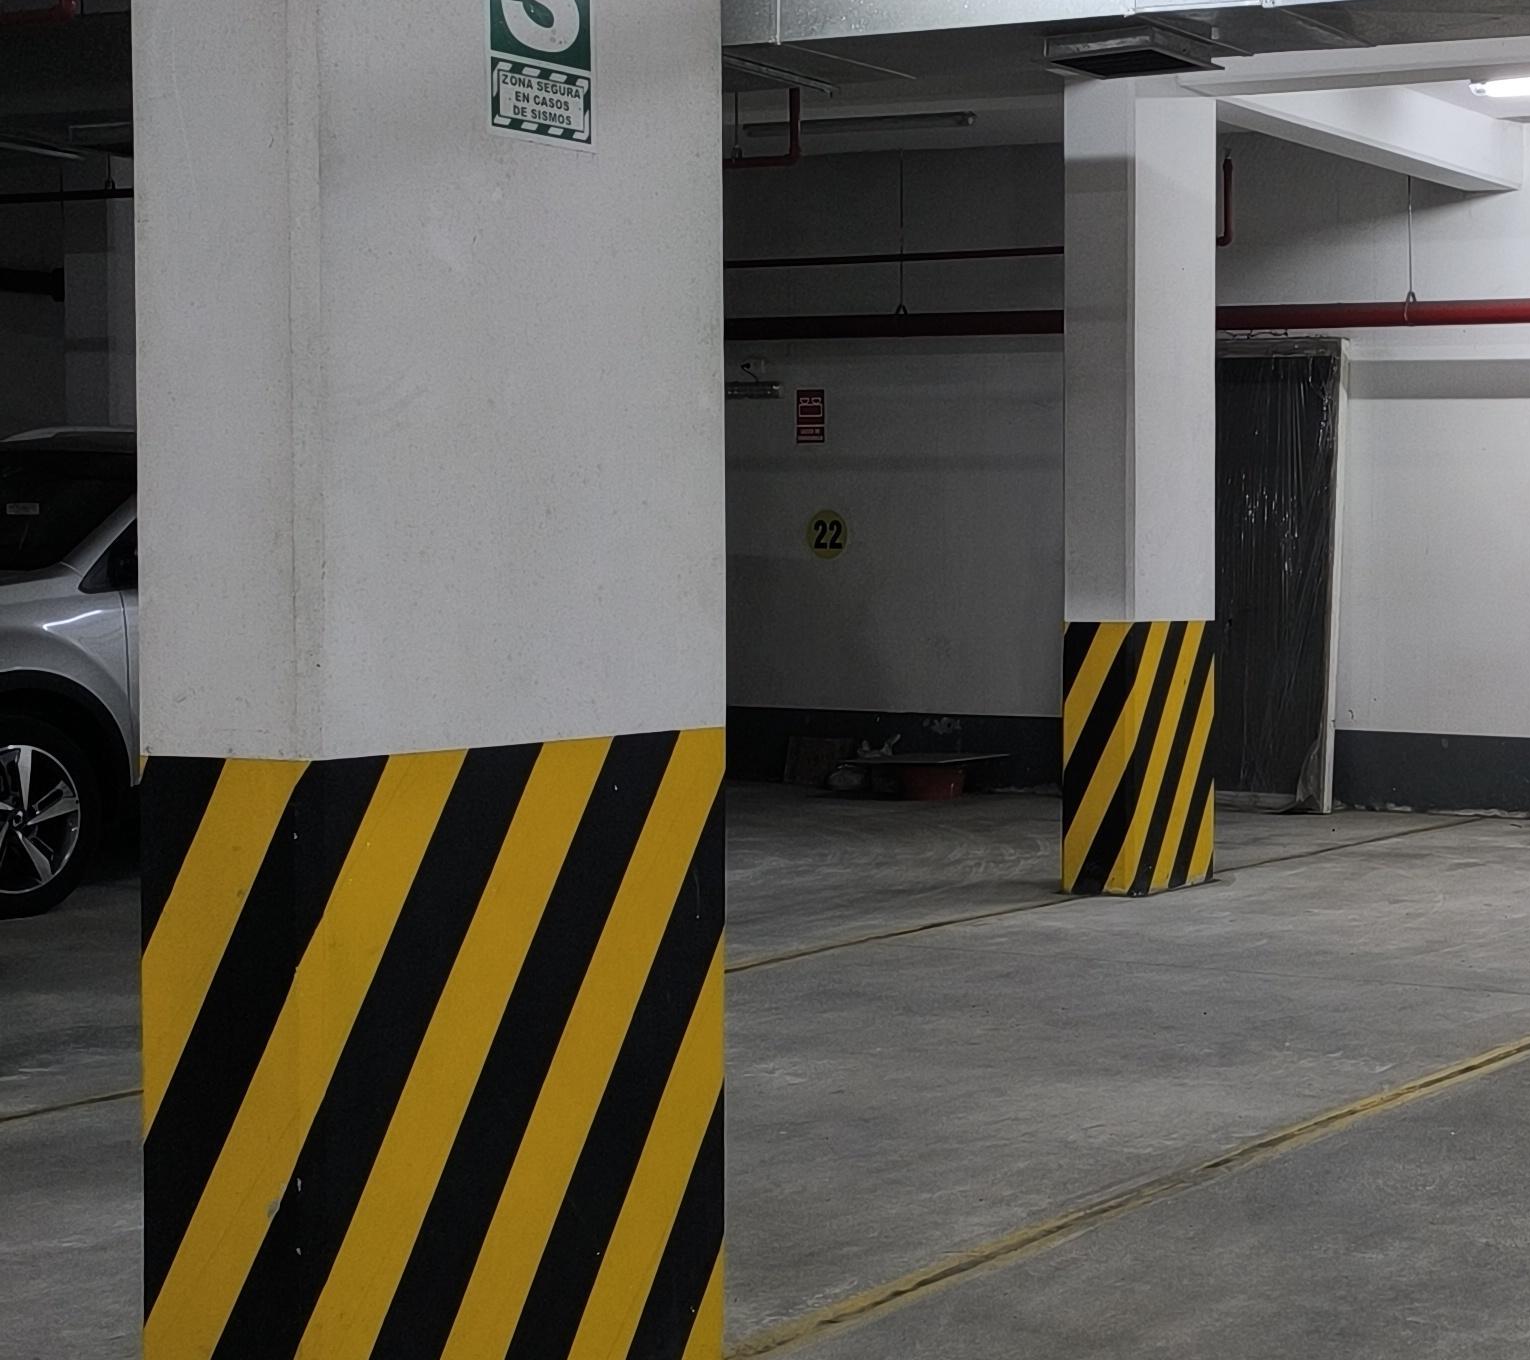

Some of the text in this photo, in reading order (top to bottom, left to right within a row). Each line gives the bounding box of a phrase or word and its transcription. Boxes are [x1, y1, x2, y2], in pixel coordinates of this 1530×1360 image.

[501, 73, 581, 99] ZONA SEGURA
[514, 91, 570, 111] EN CASOS
[513, 105, 572, 125] DE SISMOS
[813, 519, 843, 549] 22
